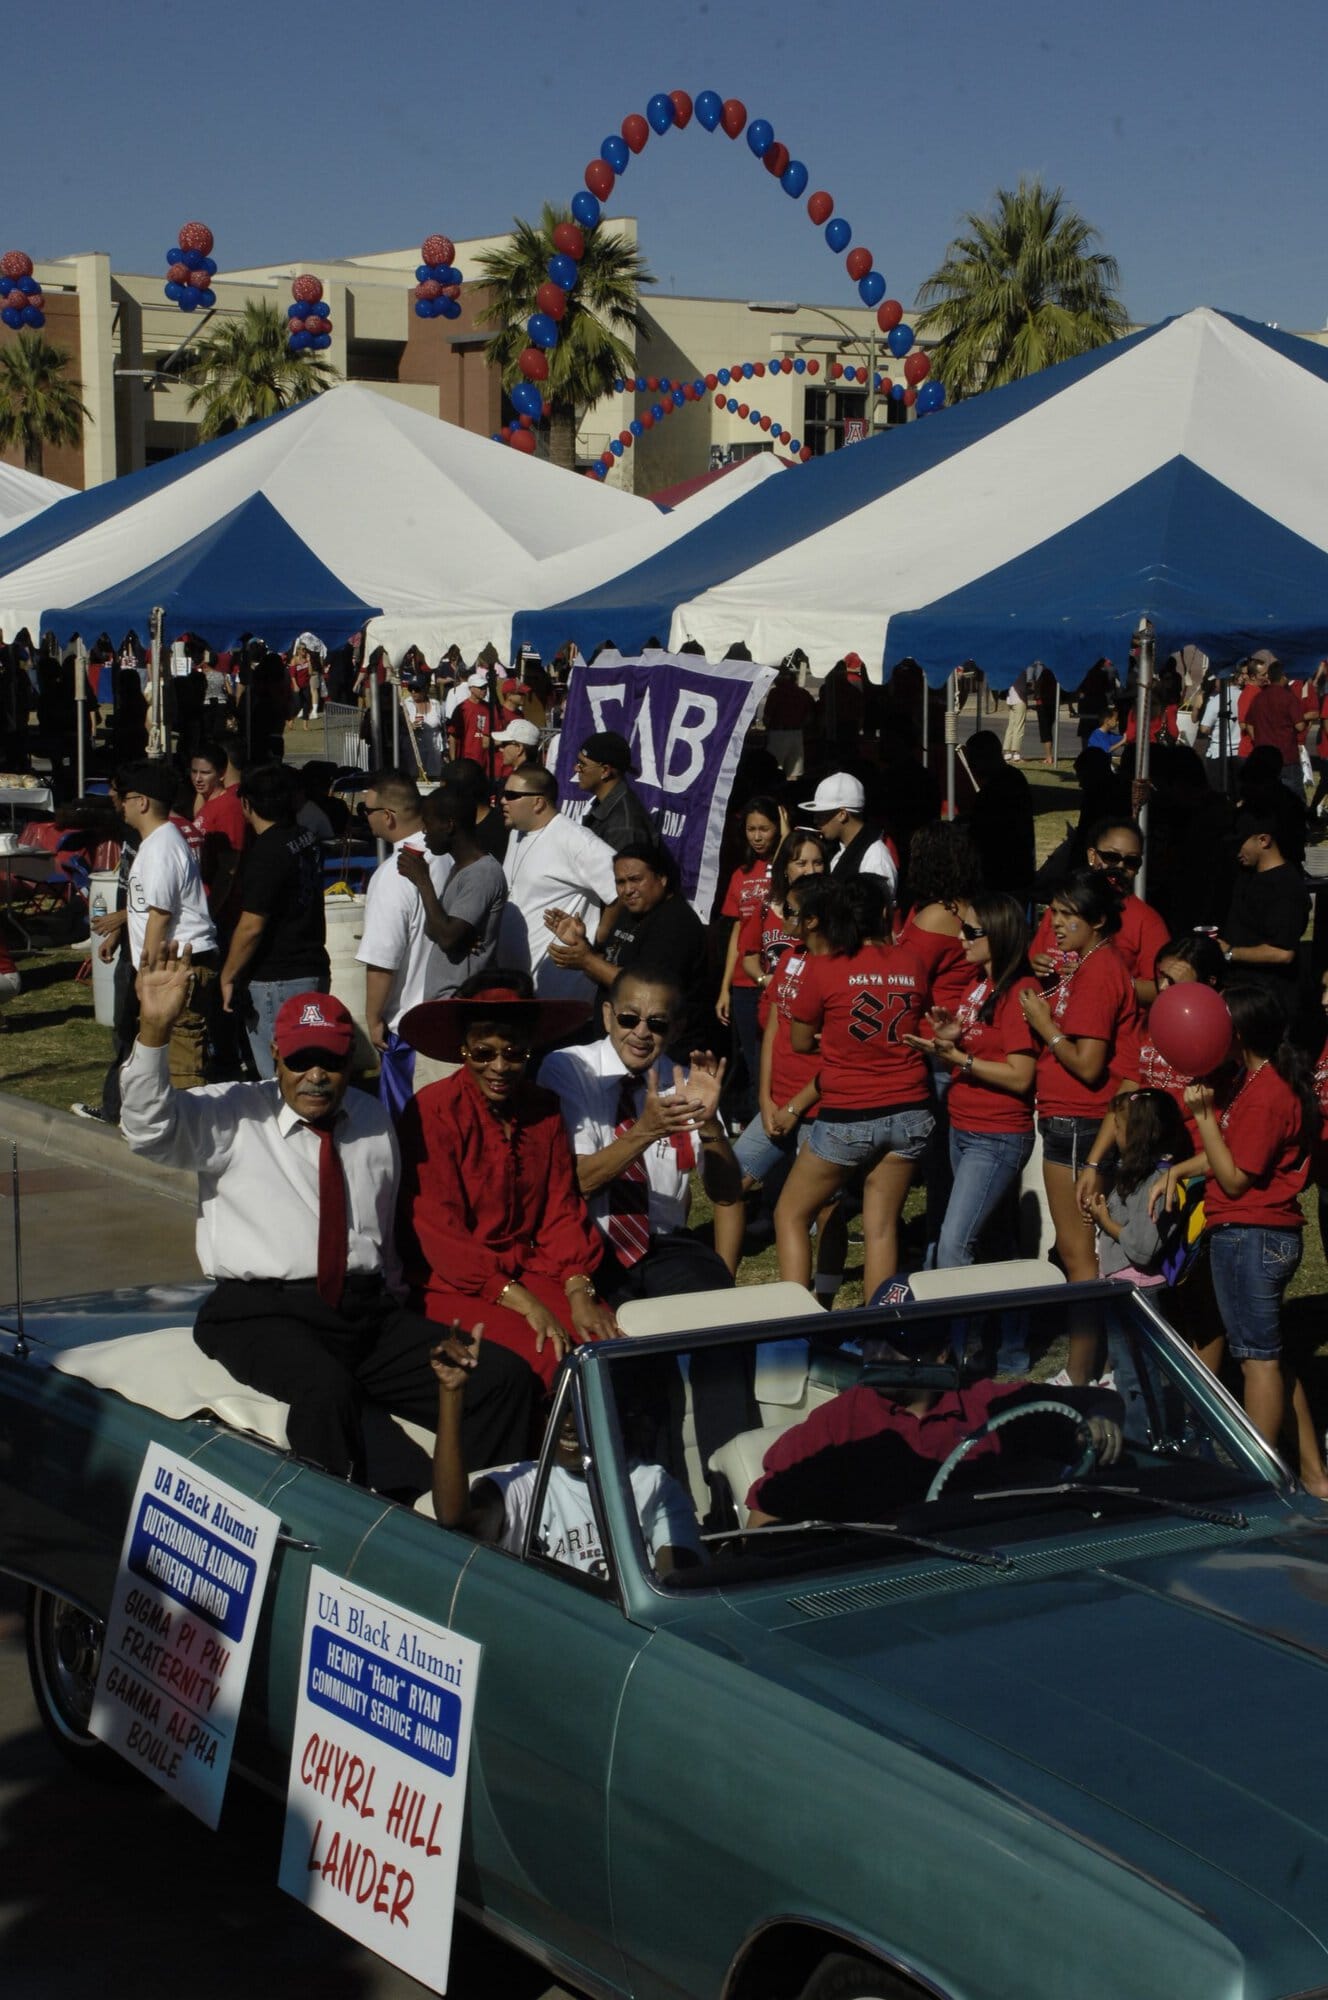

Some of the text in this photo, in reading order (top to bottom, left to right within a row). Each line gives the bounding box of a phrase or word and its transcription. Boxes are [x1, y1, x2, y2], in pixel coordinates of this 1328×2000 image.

[299, 1003, 324, 1024] A
[142, 1505, 249, 1595] OUTSTANDING ALUMNI
[155, 1467, 258, 1549] UA Black Alumni
[146, 1545, 230, 1620] ACHIEVER AWARD
[121, 1626, 220, 1712] FRATERNITY
[125, 1590, 231, 1678] SIGMA PI PHI
[318, 1592, 463, 1687] UA Black Alumni
[106, 1666, 218, 1768] GAMMA ALPHA
[312, 1667, 452, 1761] COMMUNITY SERVICE AWARD
[326, 1641, 365, 1682] HENRY
[408, 1683, 441, 1723] RYAN
[127, 1722, 182, 1779] BOULE
[301, 1733, 442, 1857] CHYRL HILL
[308, 1819, 414, 1929] LANDER
